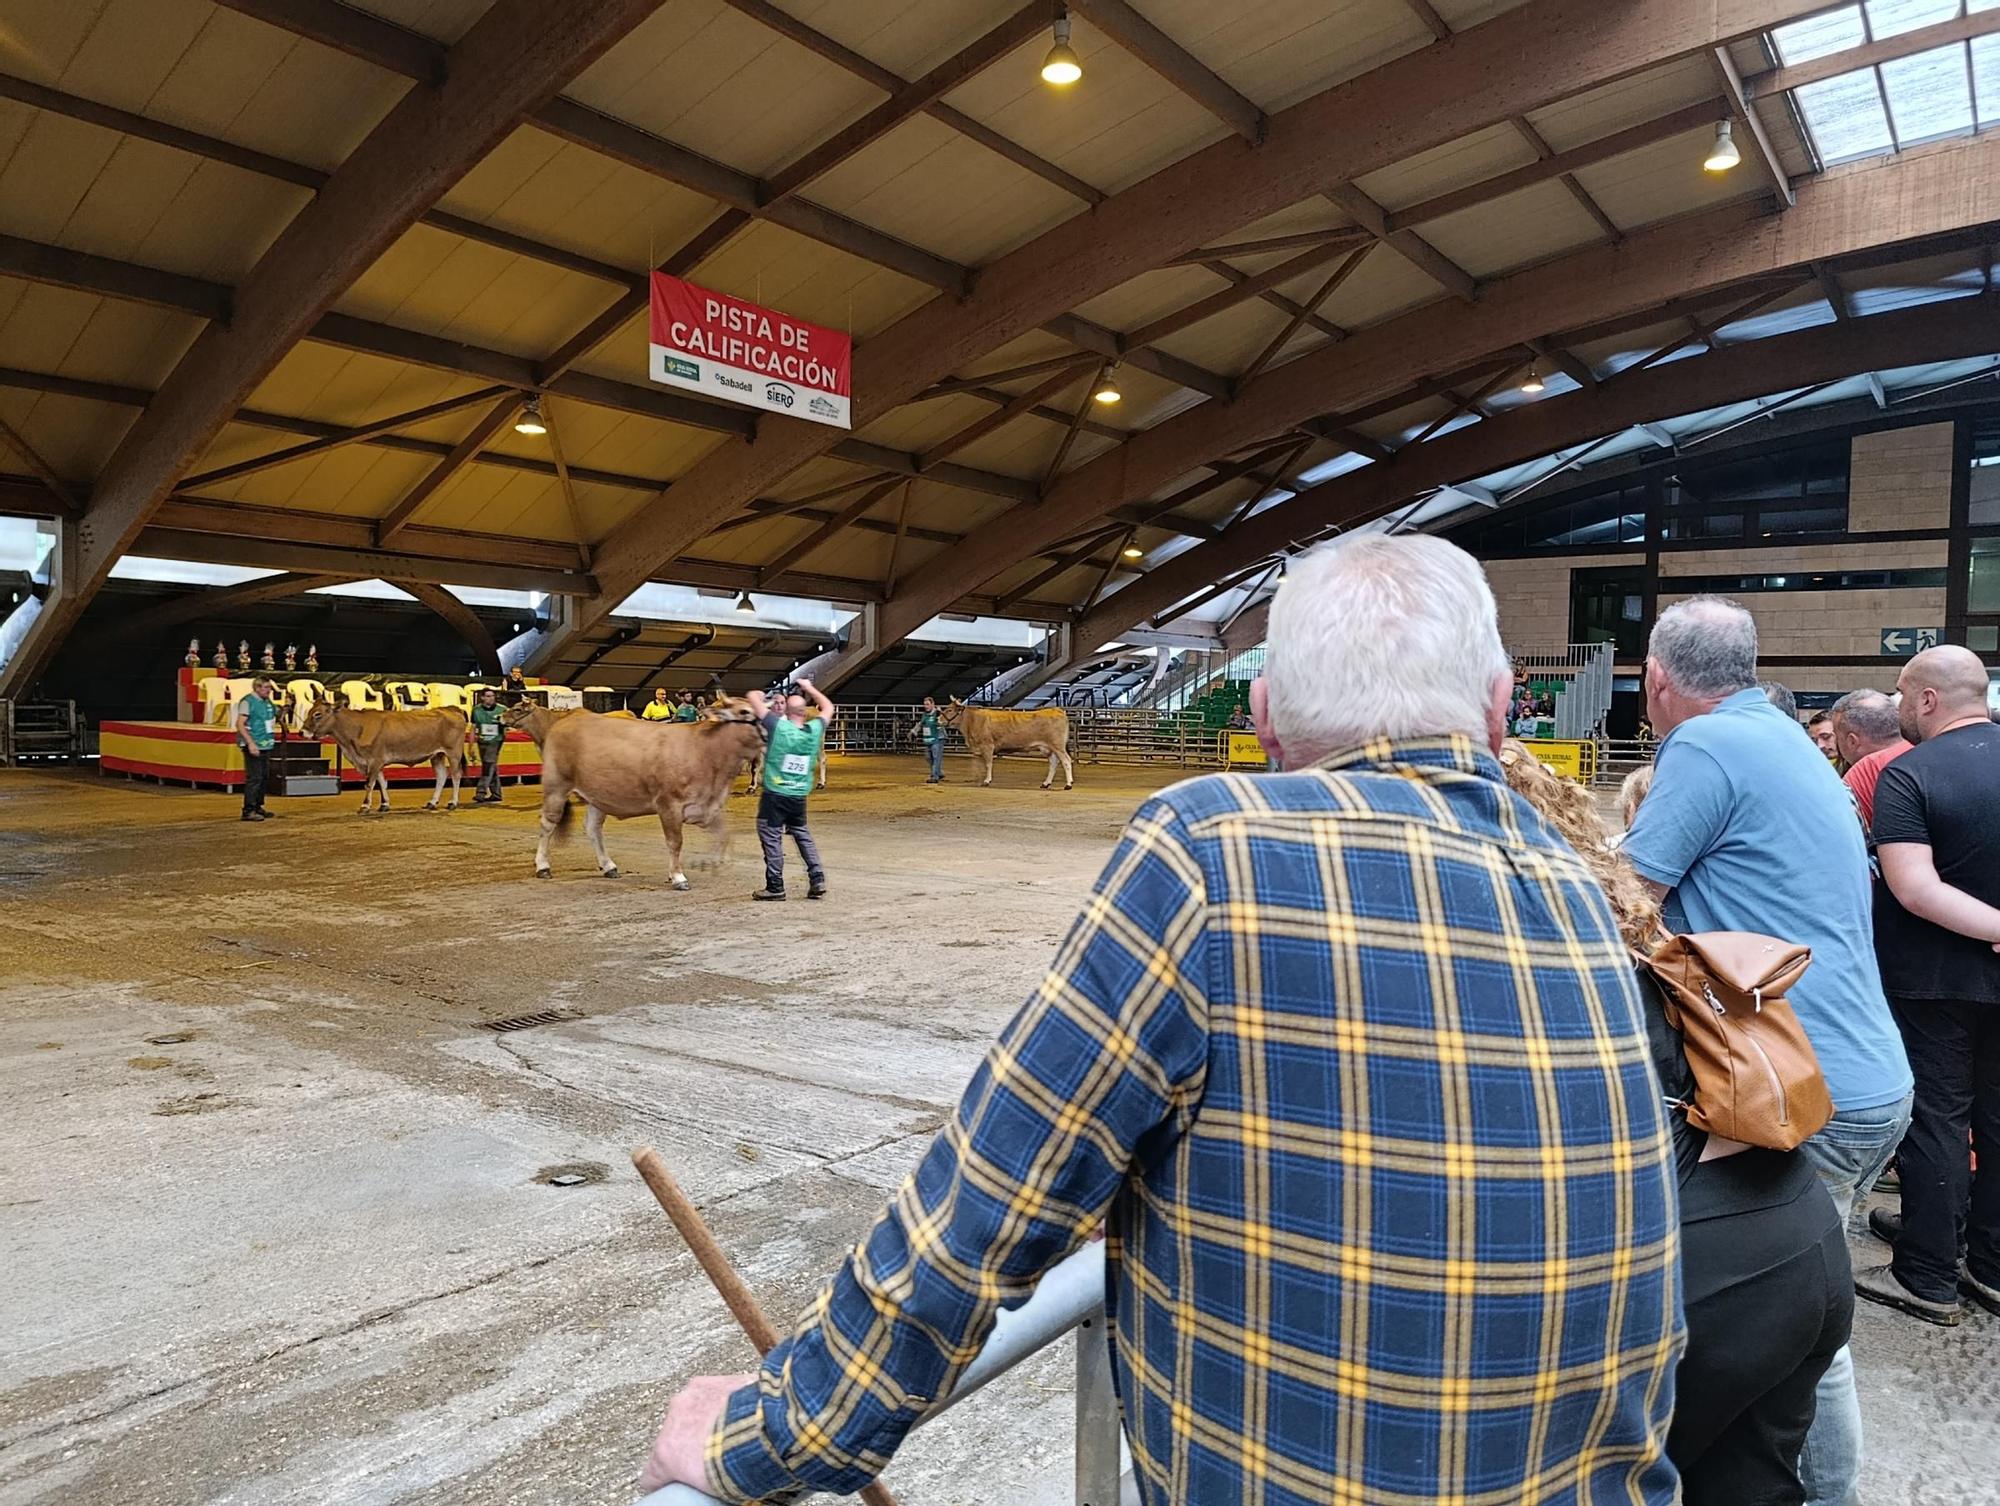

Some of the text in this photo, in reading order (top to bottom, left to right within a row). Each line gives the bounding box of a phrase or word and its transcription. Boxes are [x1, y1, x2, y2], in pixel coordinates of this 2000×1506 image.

[706, 298, 809, 352] PISTA DE
[671, 322, 836, 389] CALIFICACIÓN
[720, 376, 752, 392] Sabadell
